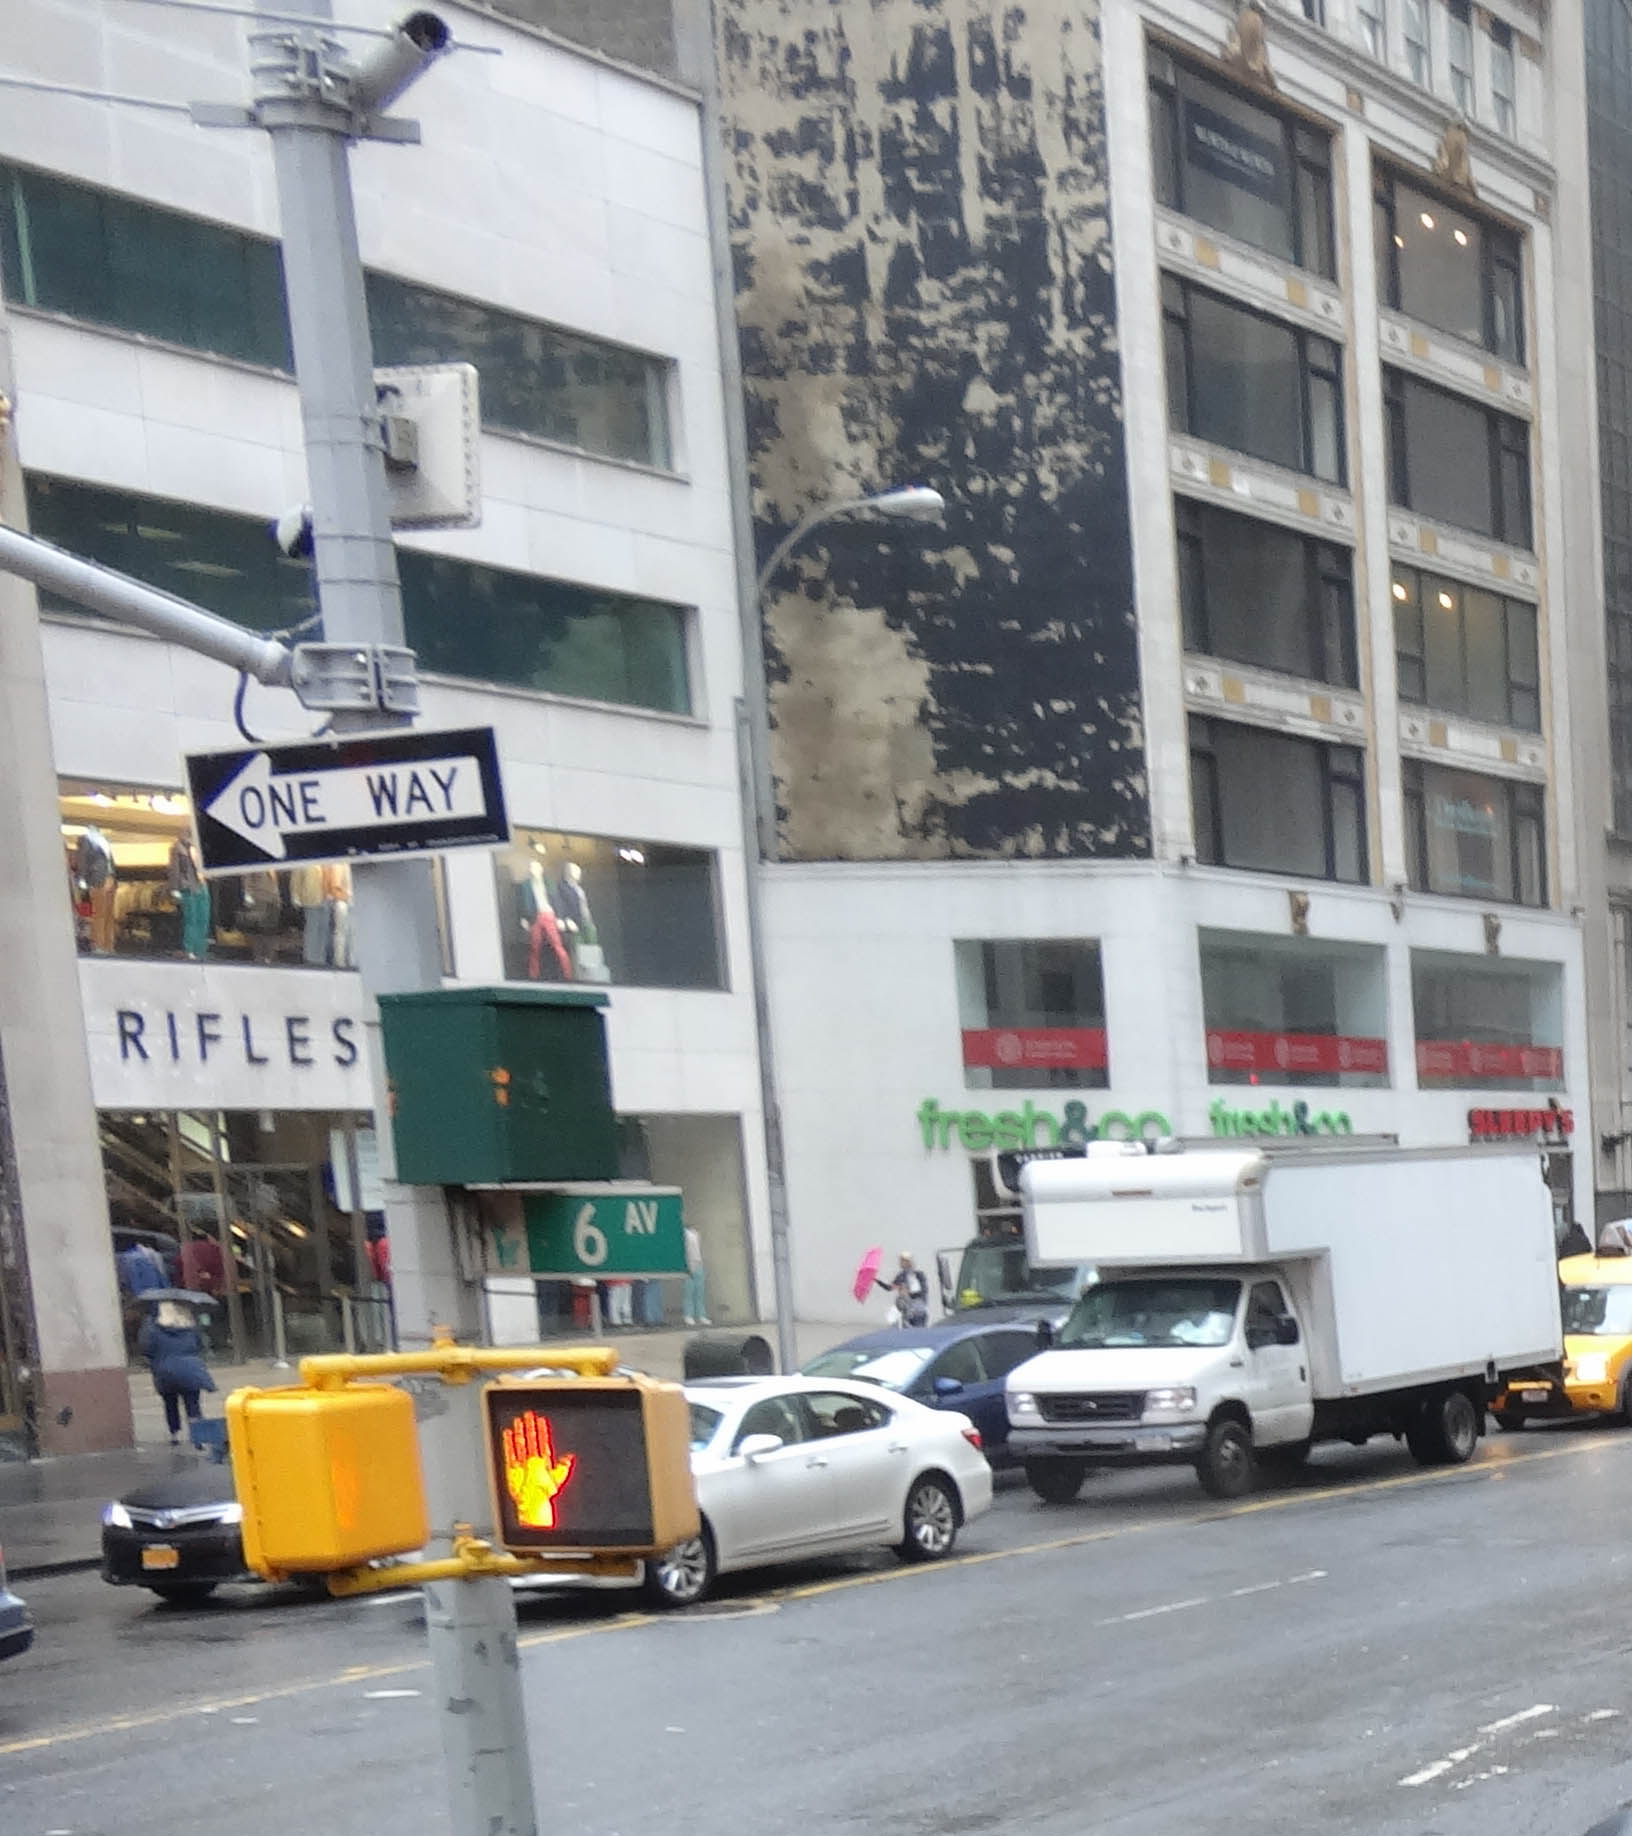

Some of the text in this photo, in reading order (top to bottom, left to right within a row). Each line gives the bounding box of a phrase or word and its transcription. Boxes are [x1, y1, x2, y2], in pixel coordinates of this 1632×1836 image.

[238, 766, 457, 829] ONE WAY
[116, 1009, 358, 1067] RIFLES
[573, 1201, 659, 1267] 6 AV
